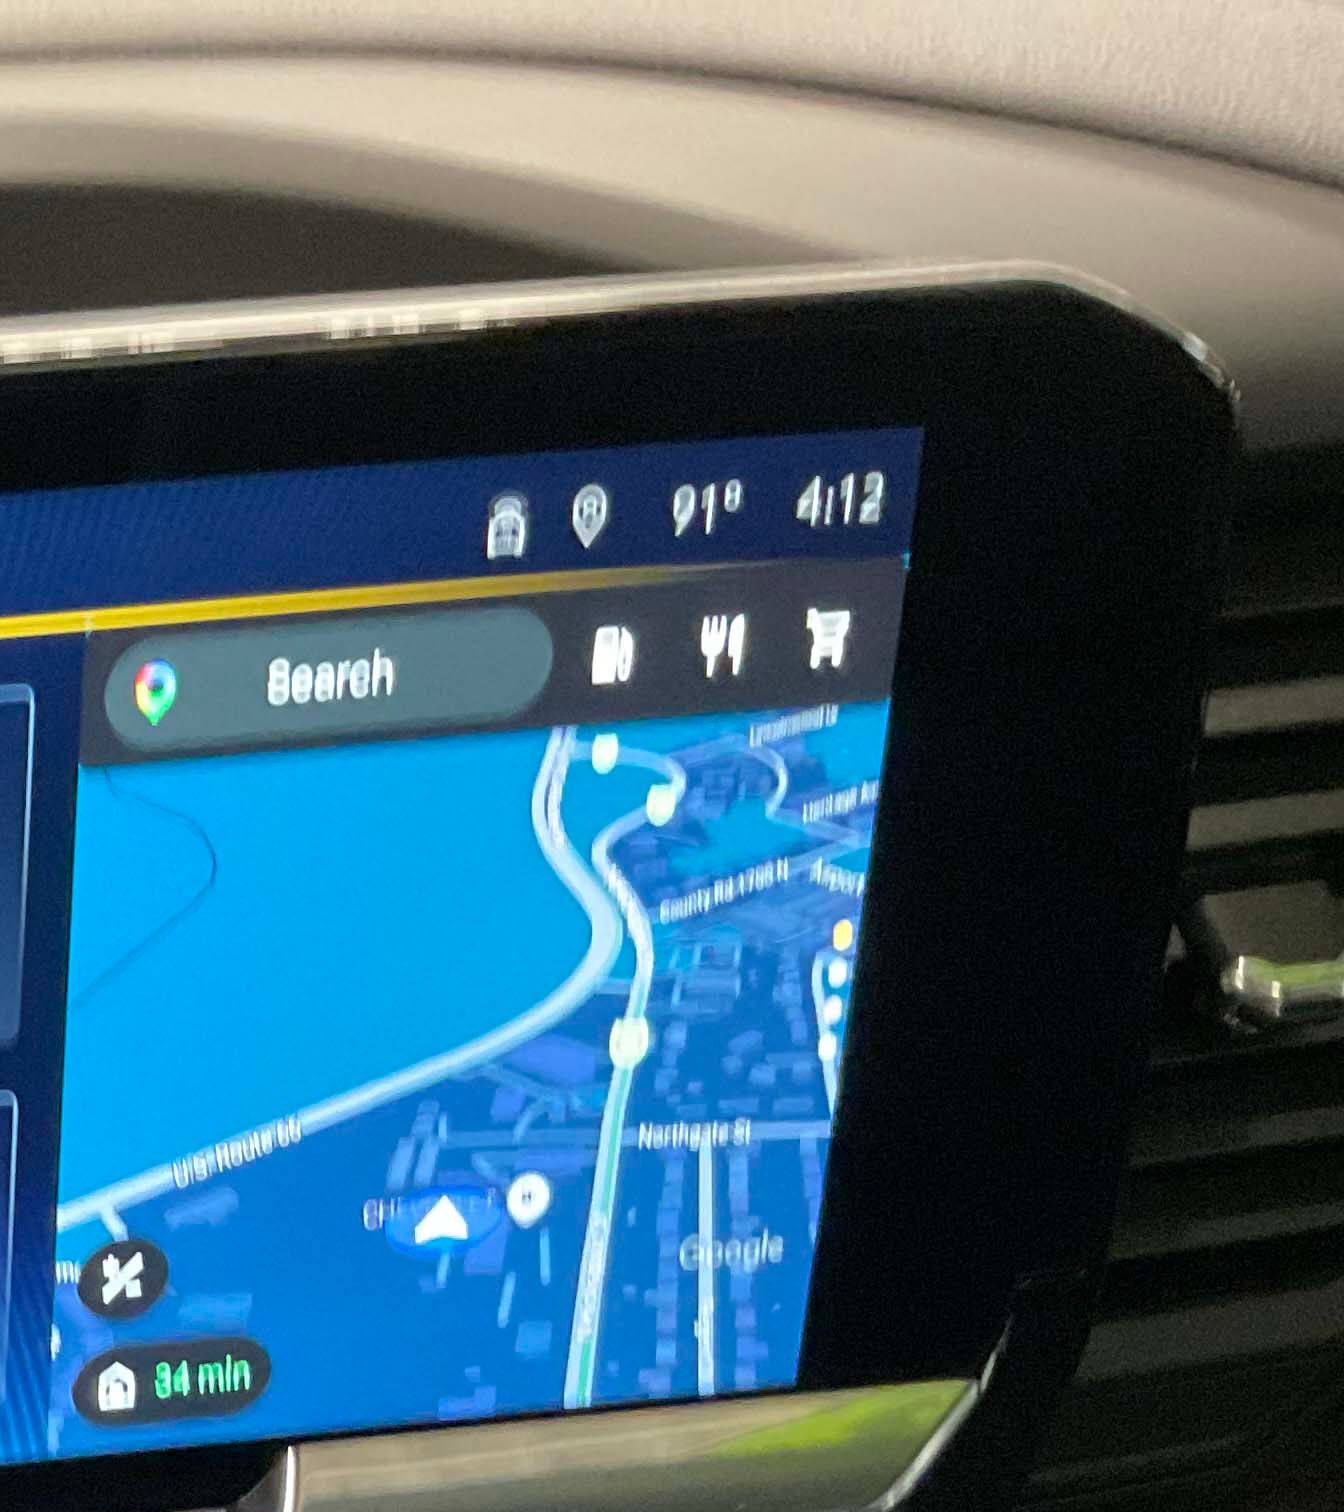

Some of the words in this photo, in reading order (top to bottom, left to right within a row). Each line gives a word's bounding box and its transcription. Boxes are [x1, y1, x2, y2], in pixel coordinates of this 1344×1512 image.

[796, 470, 886, 529] 4:12
[266, 648, 395, 708] Search
[679, 1227, 785, 1274] Google
[154, 1361, 191, 1399] 34
[198, 1354, 252, 1395] min
